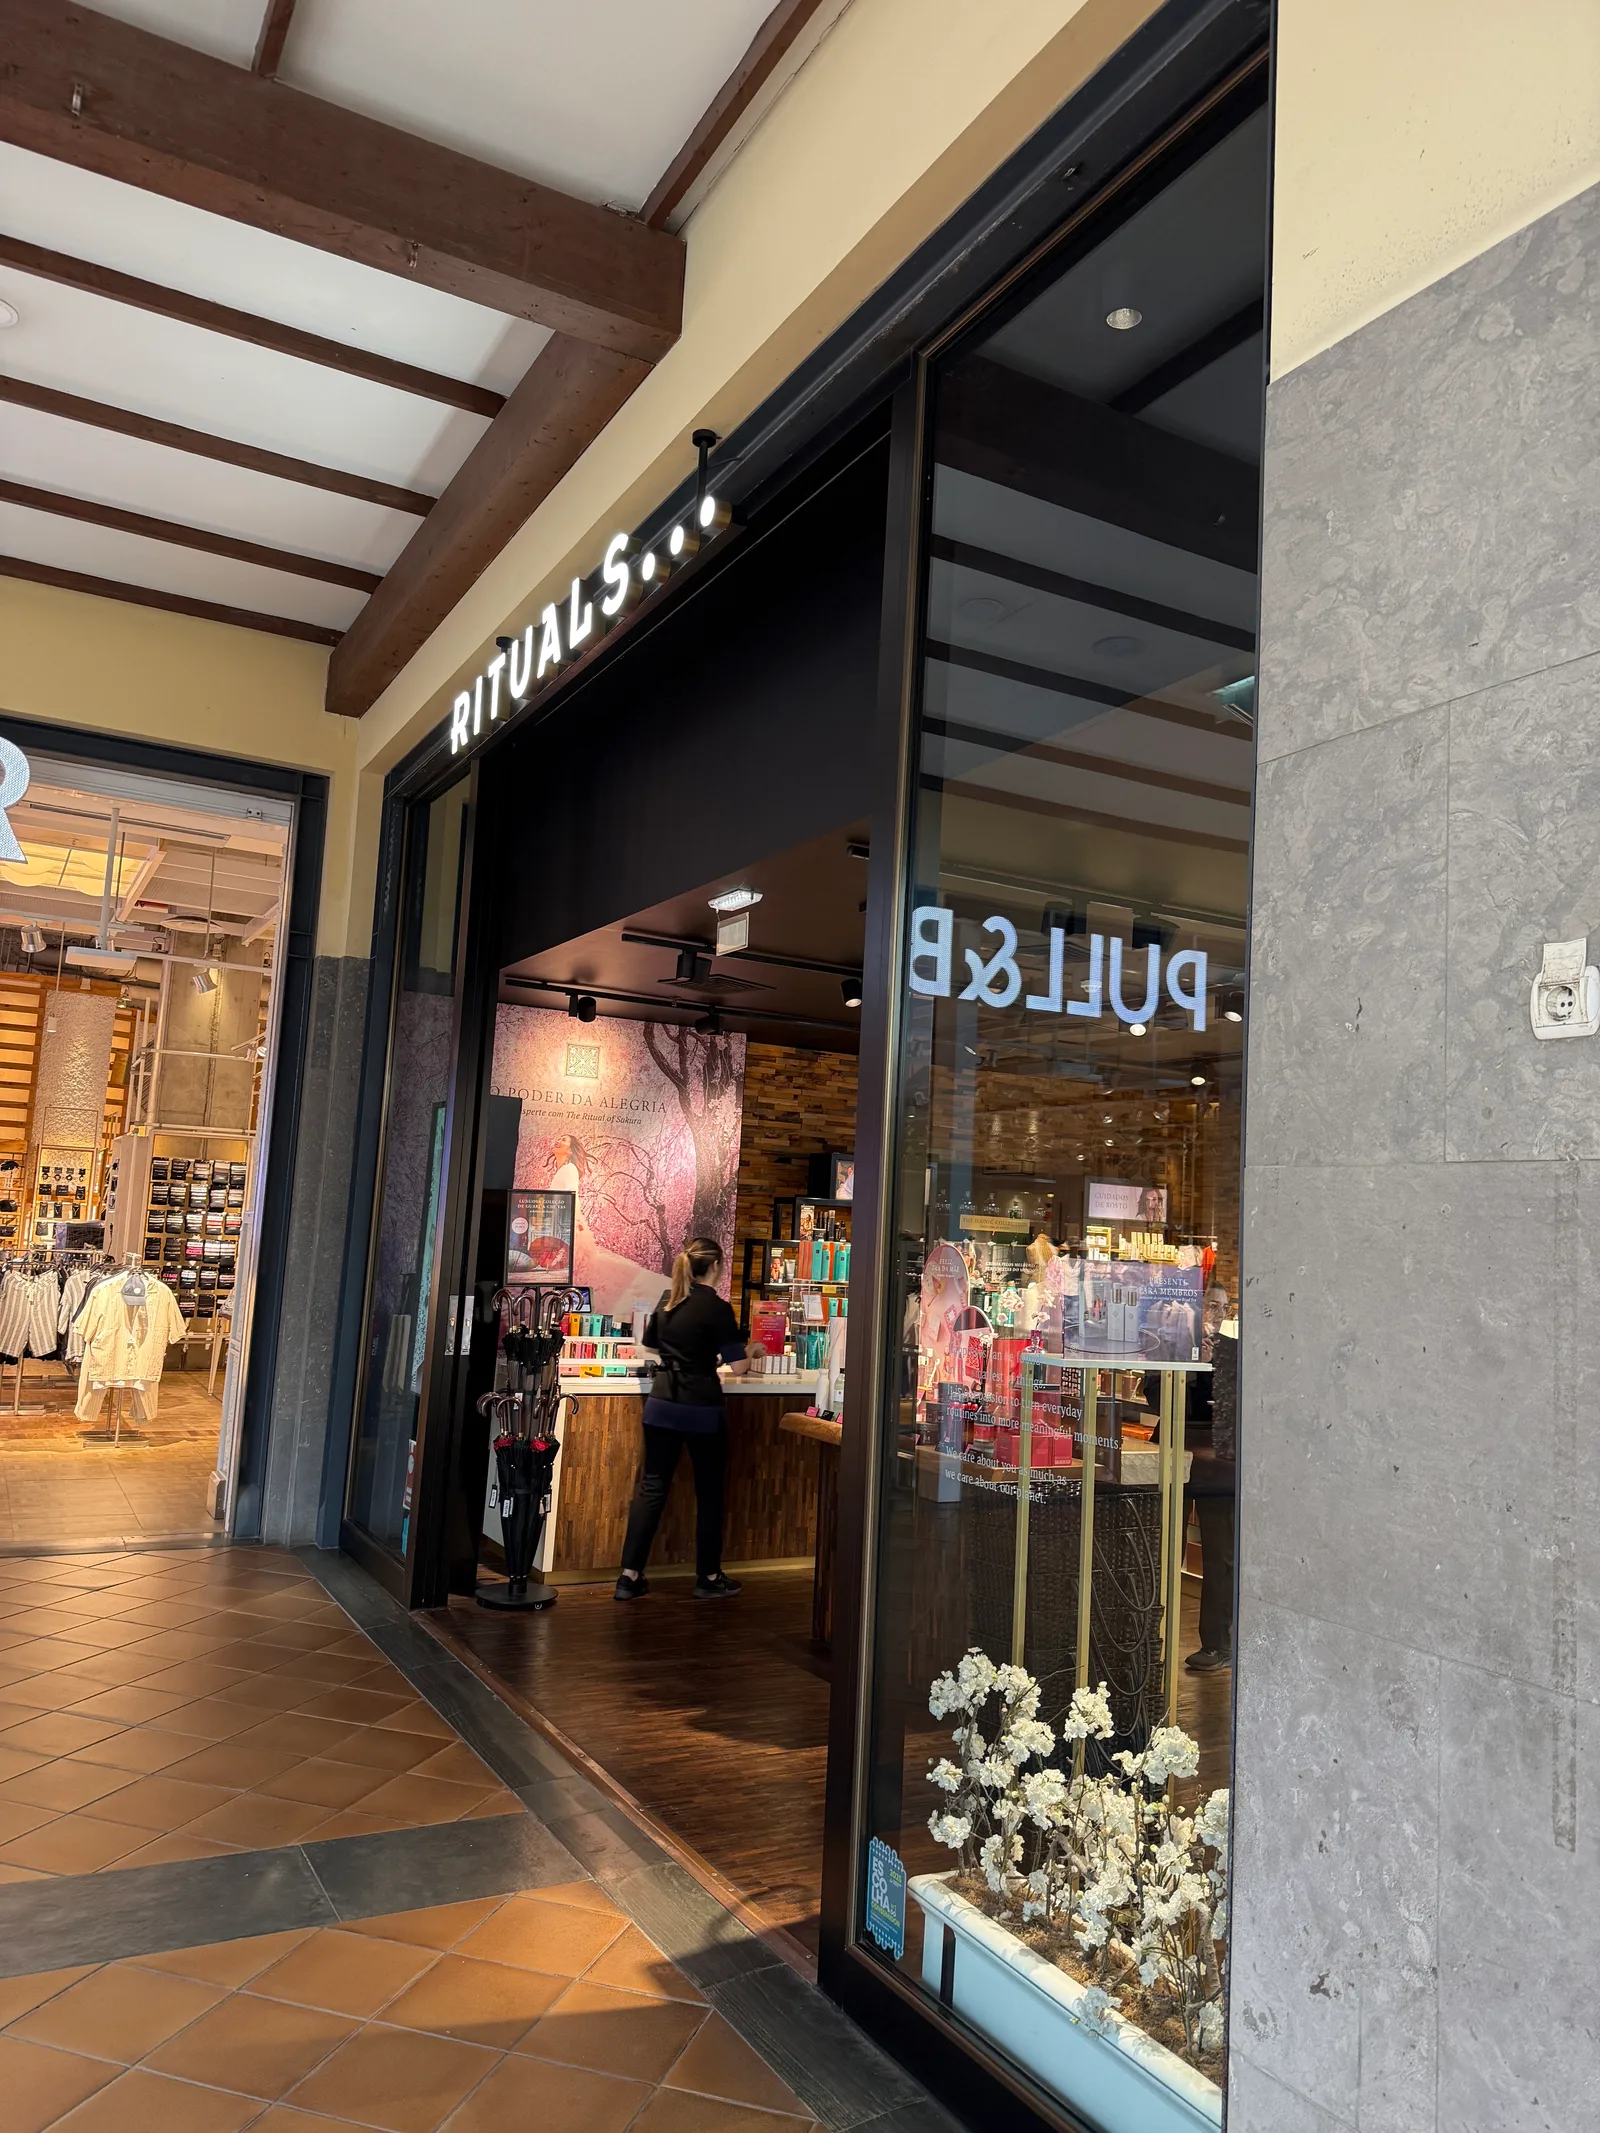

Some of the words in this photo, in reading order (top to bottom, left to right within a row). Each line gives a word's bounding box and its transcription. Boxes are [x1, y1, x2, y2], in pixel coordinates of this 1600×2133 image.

[508, 1087, 564, 1104] PODER
[571, 1093, 593, 1106] DA
[600, 1096, 667, 1113] ALEGRIA
[521, 1108, 547, 1118] sperte
[565, 1110, 581, 1120] The
[582, 1112, 605, 1122] Ritual
[606, 1114, 616, 1124] of
[616, 1115, 642, 1125] Sakura
[1094, 1192, 1129, 1201] CUIDADOS
[1106, 1202, 1128, 1210] ROSTO
[1160, 1287, 1198, 1297] MEMBROS
[1010, 1397, 1019, 1407] to
[1042, 1402, 1083, 1421] everyday
[946, 1406, 977, 1421] routines
[980, 1412, 996, 1425] into
[999, 1417, 1019, 1430] more
[1021, 1420, 1072, 1441] meaningful
[1074, 1431, 1122, 1450] moments.
[946, 1445, 957, 1458] We
[959, 1451, 975, 1464] care
[977, 1453, 1000, 1468] about
[1001, 1460, 1017, 1474] you
[1018, 1466, 1028, 1476] as
[1030, 1468, 1055, 1483] much
[1056, 1475, 1067, 1486] as
[945, 1469, 955, 1480] we
[957, 1472, 974, 1484] care
[975, 1475, 998, 1492] about
[1000, 1484, 1014, 1496] our
[1016, 1486, 1047, 1504] planet.
[872, 1856, 884, 1877] ES
[872, 1872, 888, 1894] CO
[871, 1886, 890, 1913] LHA
